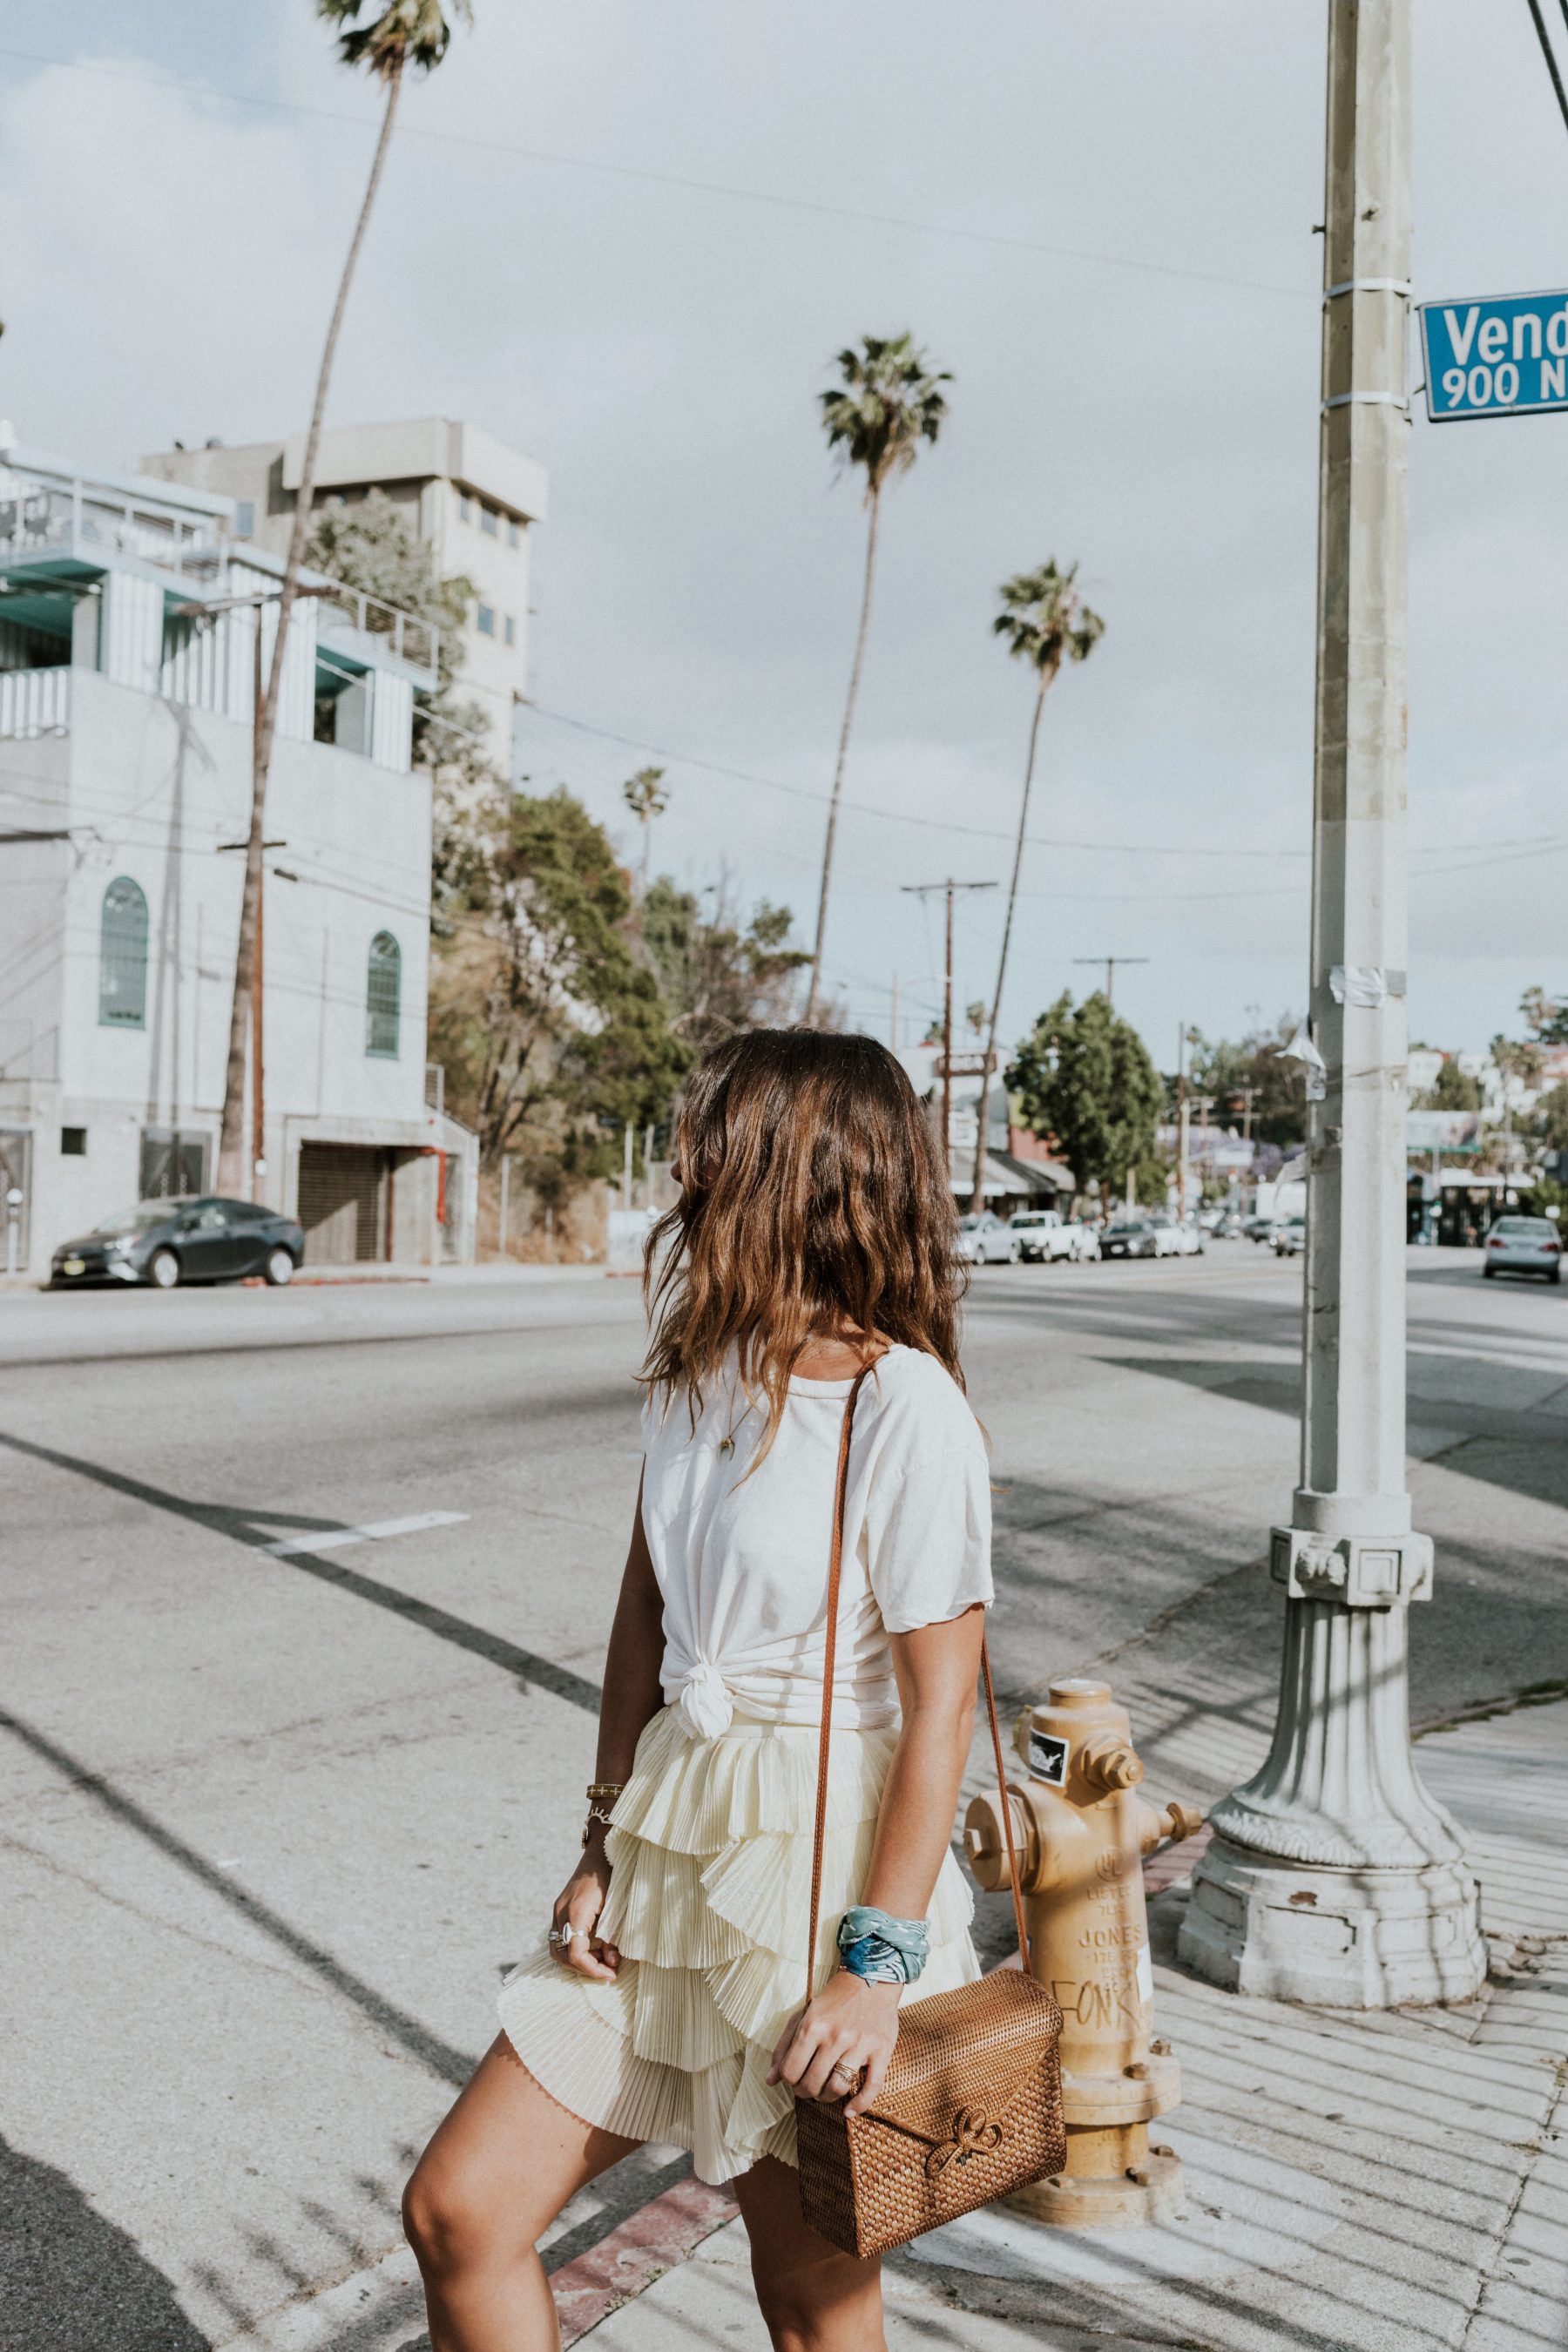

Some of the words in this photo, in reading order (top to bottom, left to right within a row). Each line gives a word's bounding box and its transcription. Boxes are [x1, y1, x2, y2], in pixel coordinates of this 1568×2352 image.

[1442, 362, 1519, 409] 900
[1540, 358, 1565, 400] N
[1078, 1923, 1141, 1948] JONES
